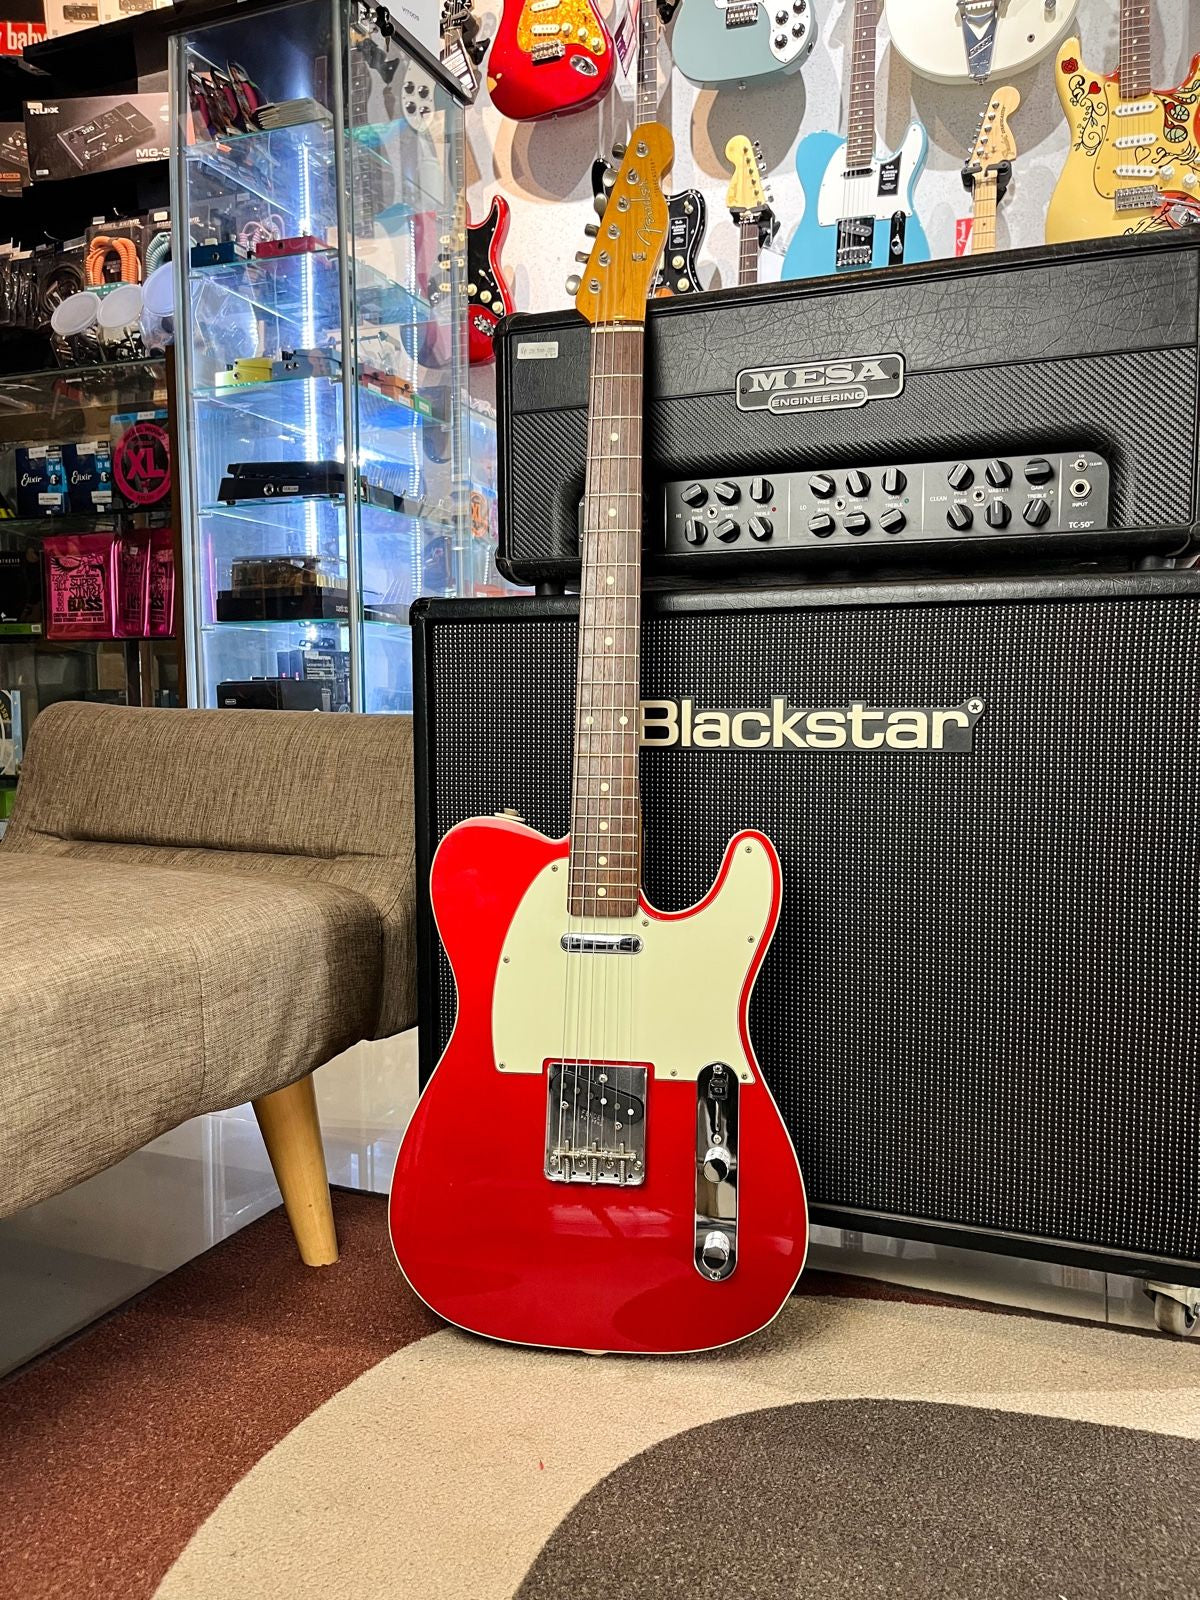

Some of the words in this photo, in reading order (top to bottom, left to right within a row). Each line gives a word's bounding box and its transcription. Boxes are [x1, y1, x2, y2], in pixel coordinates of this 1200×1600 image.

[631, 178, 663, 245] Fender
[748, 360, 890, 393] MESA
[771, 391, 865, 407] ENGINEERING
[21, 473, 43, 487] Elixir
[71, 470, 92, 485] Elixir
[126, 447, 165, 480] XL
[639, 699, 971, 749] Blackstar
